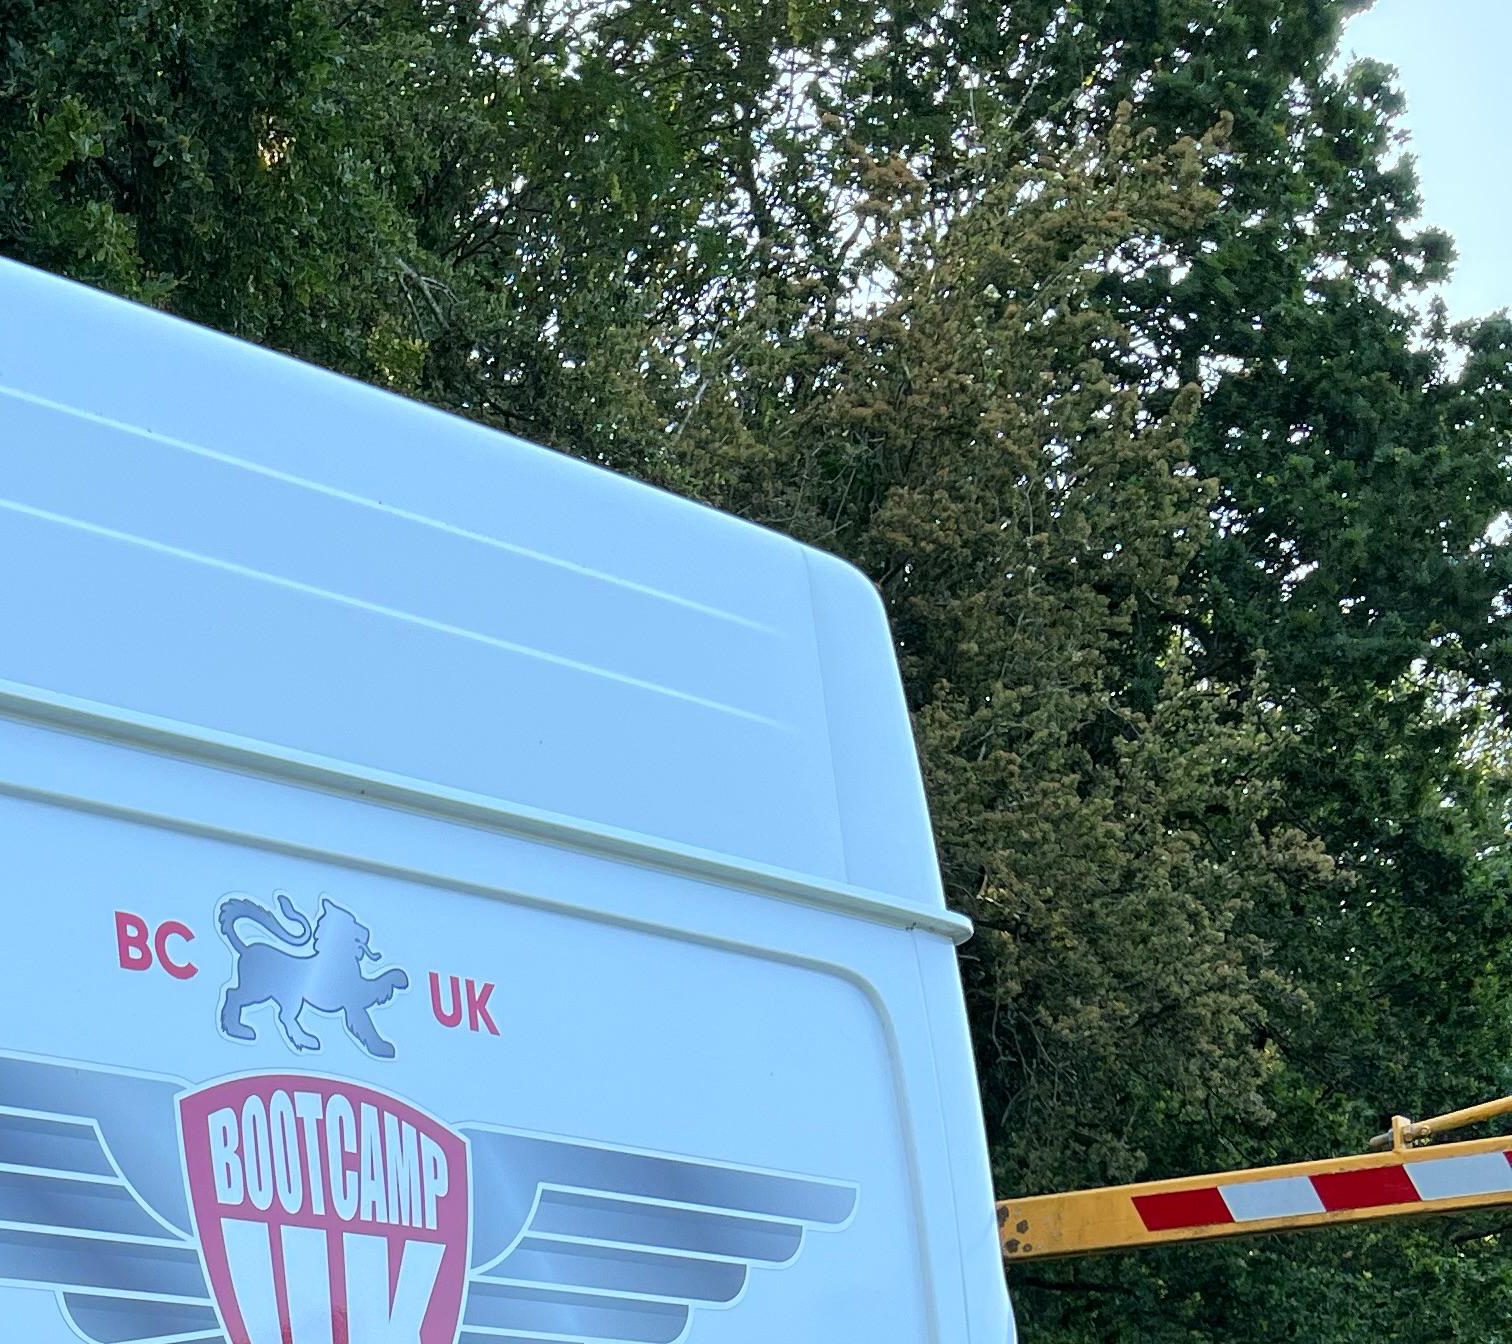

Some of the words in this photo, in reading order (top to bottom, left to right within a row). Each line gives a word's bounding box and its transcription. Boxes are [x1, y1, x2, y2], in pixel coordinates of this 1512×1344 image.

[114, 911, 199, 980] BC
[428, 971, 501, 1037] UK
[207, 1089, 449, 1231] BOOTCAMP
